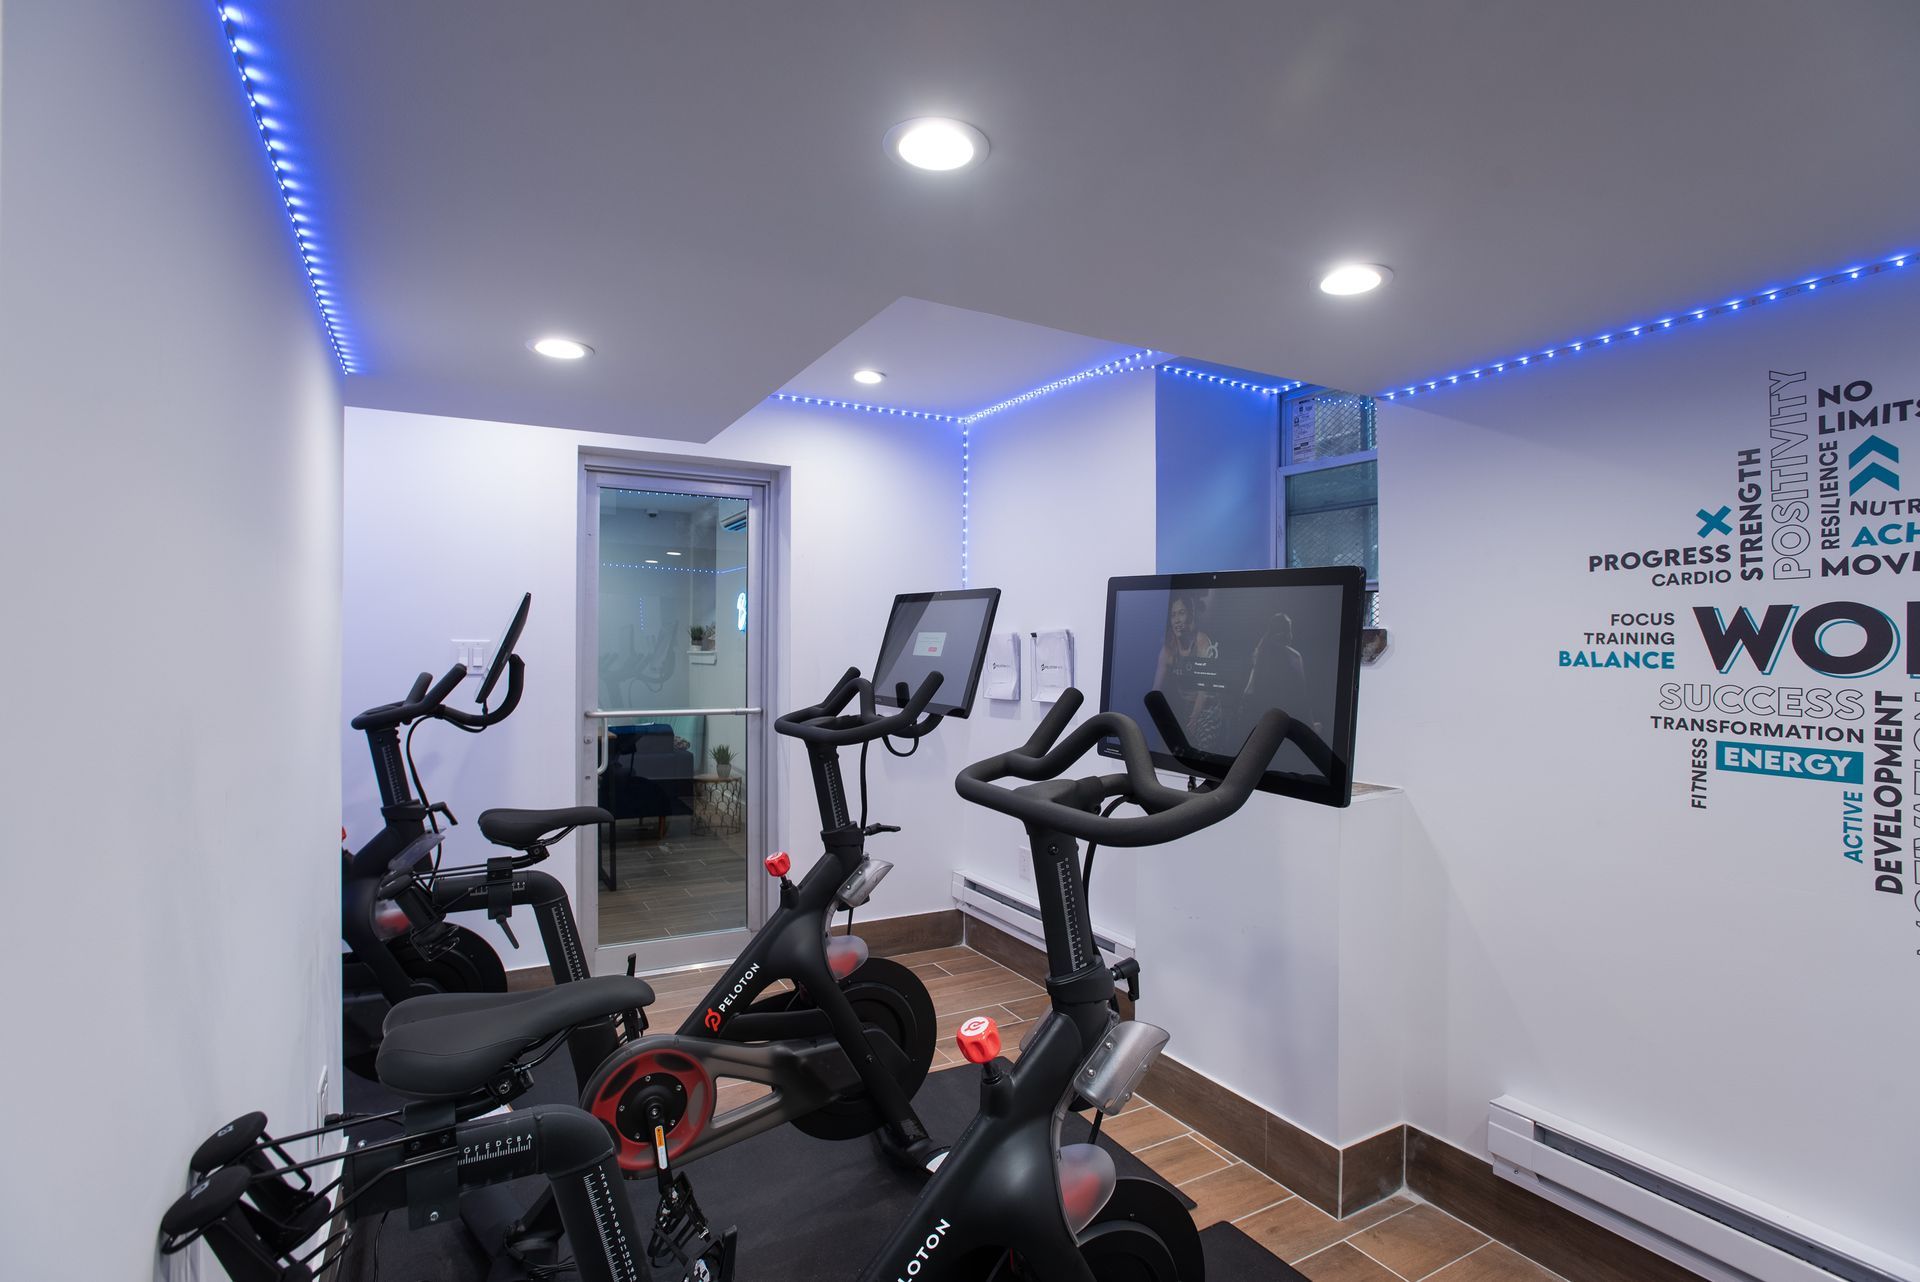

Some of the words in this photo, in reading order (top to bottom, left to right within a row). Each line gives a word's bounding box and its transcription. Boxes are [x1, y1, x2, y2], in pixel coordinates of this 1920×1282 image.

[1818, 380, 1873, 408] NO
[1769, 370, 1811, 580] POSITIVITY
[1738, 448, 1763, 581] STRENGTH
[1819, 440, 1841, 550] RESILIENCE
[1589, 544, 1731, 573] PROGRESS
[1652, 569, 1732, 588] CARDIO
[1583, 632, 1675, 646] TRAINING
[1610, 612, 1675, 627] FOCUS
[1692, 600, 1920, 680] WO
[1558, 651, 1675, 670] BALANCE
[1658, 682, 1865, 721] SUCCESS
[1650, 715, 1865, 744] TRANSFORMATION
[1691, 737, 1708, 809] FITNESS
[1723, 746, 1853, 778] ENERGY
[1873, 690, 1903, 895] DEVELOPMENT
[1843, 791, 1864, 864] ACTIVE
[718, 963, 760, 1012] PELOTON
